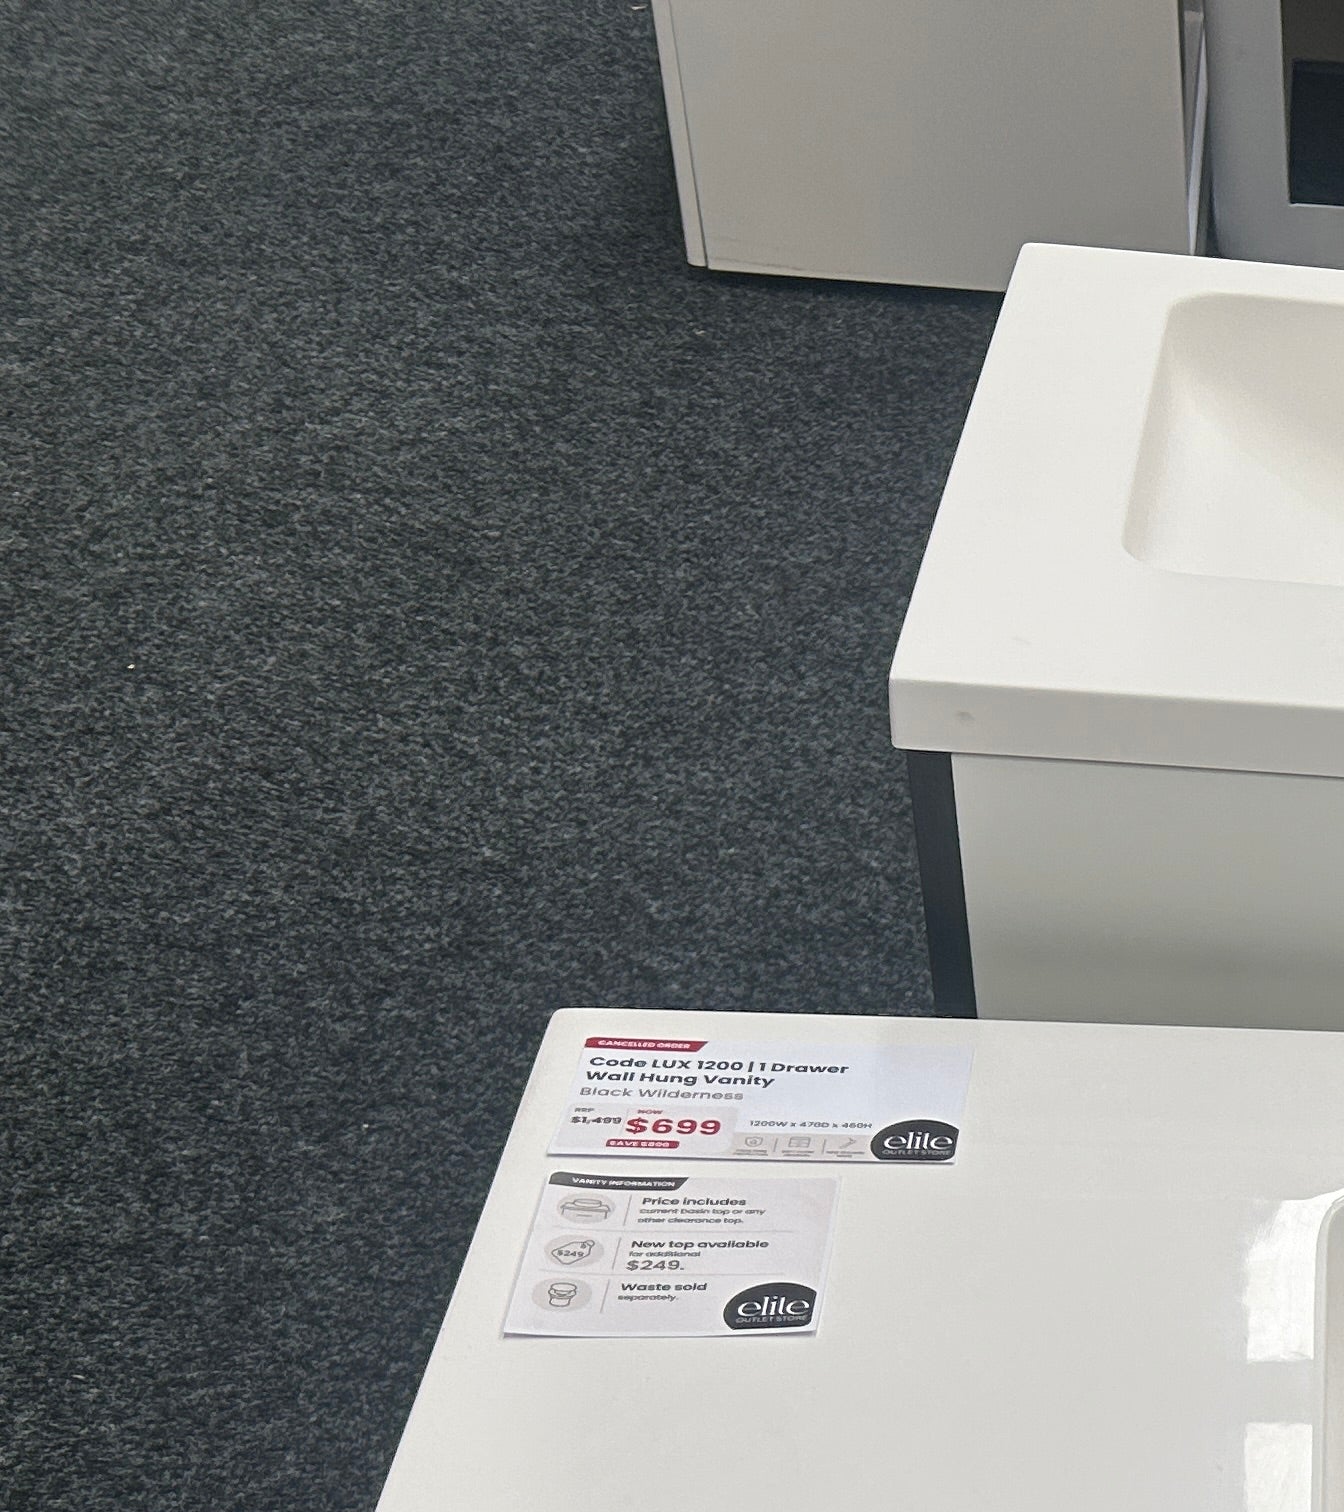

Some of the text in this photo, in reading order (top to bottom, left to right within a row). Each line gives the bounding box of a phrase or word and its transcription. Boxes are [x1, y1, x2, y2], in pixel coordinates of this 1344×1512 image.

[598, 1040, 655, 1048] CANCELLED
[590, 1057, 647, 1067] Code
[651, 1059, 692, 1069] LUX
[697, 1060, 744, 1071] 1200
[759, 1062, 767, 1072] 1
[771, 1063, 849, 1073] Drawer
[586, 1071, 775, 1088] Wall Hung Vanity
[580, 1087, 744, 1100] Black Wilderness
[571, 1116, 622, 1124] $1,499
[625, 1117, 721, 1135] $699
[572, 1177, 675, 1187] VANITY INFORMATION
[642, 1197, 746, 1206] Price includes
[631, 1240, 769, 1250] New top available
[626, 1260, 684, 1271] $249.
[621, 1283, 708, 1291] Waste sold
